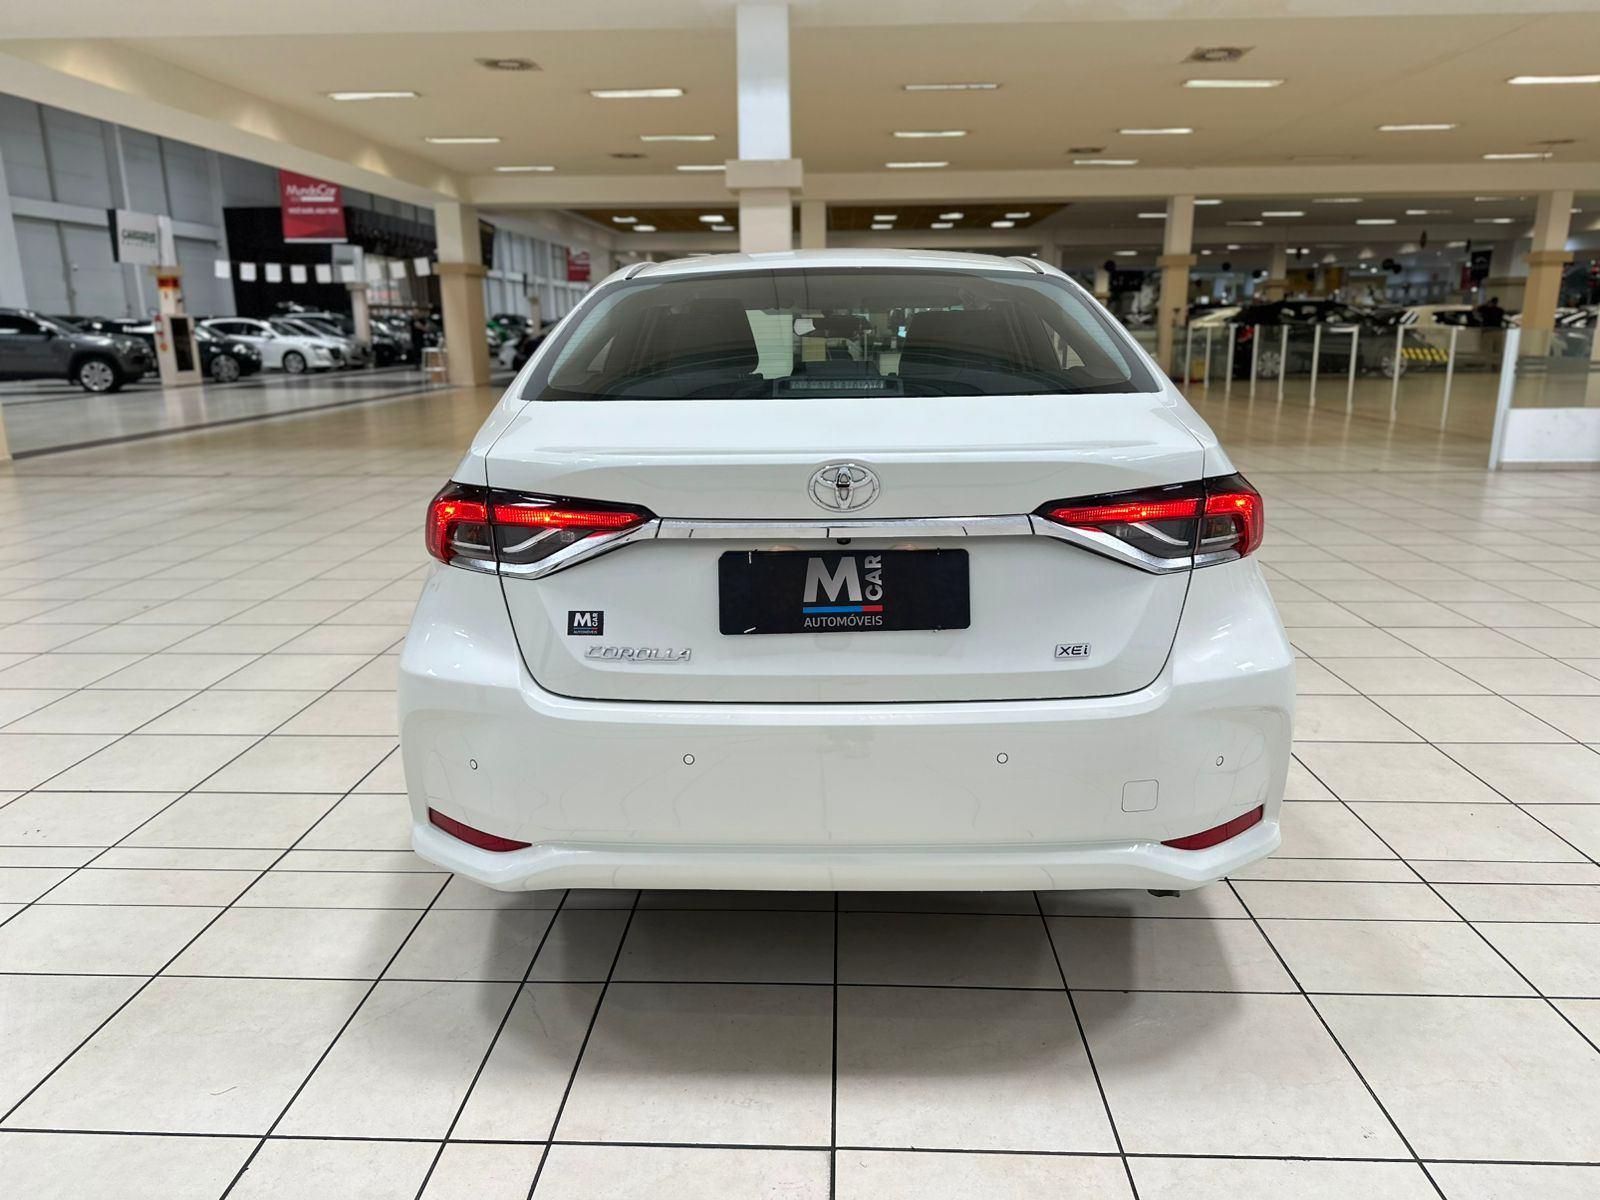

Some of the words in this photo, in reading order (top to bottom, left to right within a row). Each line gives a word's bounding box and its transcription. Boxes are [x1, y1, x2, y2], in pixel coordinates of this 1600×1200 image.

[803, 556, 863, 602] M
[864, 555, 883, 601] CAR
[573, 612, 592, 627] M
[803, 613, 883, 628] AUTOMÓVEIS
[584, 646, 692, 662] COROLLA
